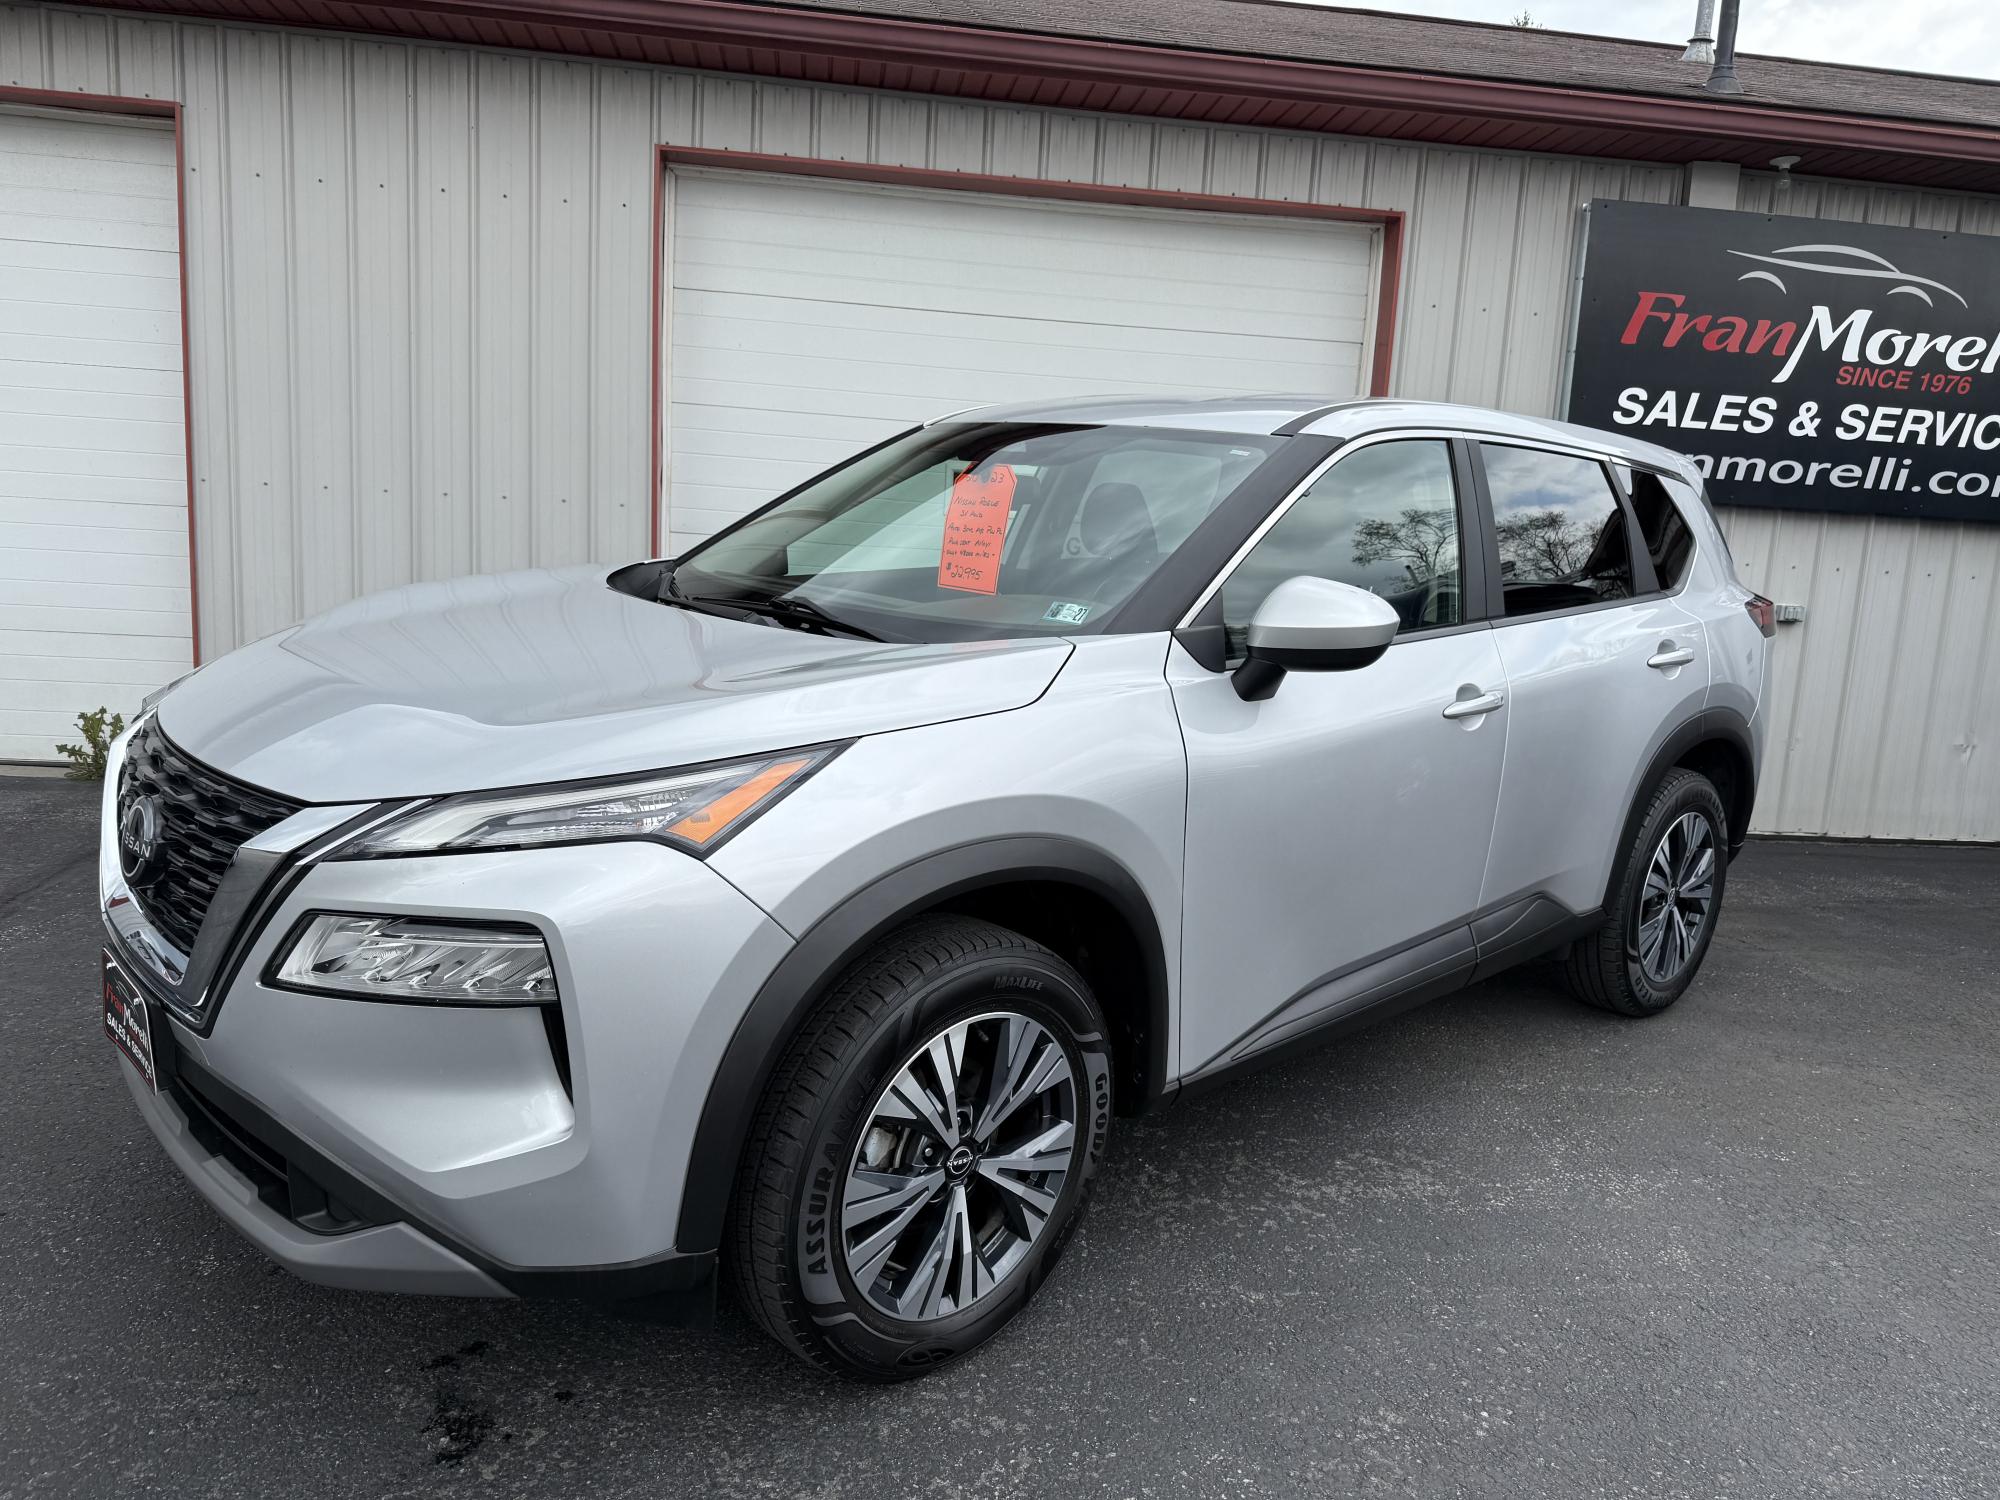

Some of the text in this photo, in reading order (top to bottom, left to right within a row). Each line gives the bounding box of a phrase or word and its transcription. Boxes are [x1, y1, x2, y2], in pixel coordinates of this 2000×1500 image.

[1836, 366, 1972, 395] SINCE 1976
[1612, 387, 2000, 450] SALES & SERVIC
[1683, 453, 2000, 498] nmorelli.co
[1072, 607, 1089, 622] 27
[107, 1012, 126, 1041] SALES
[131, 1041, 153, 1079] SERVICE
